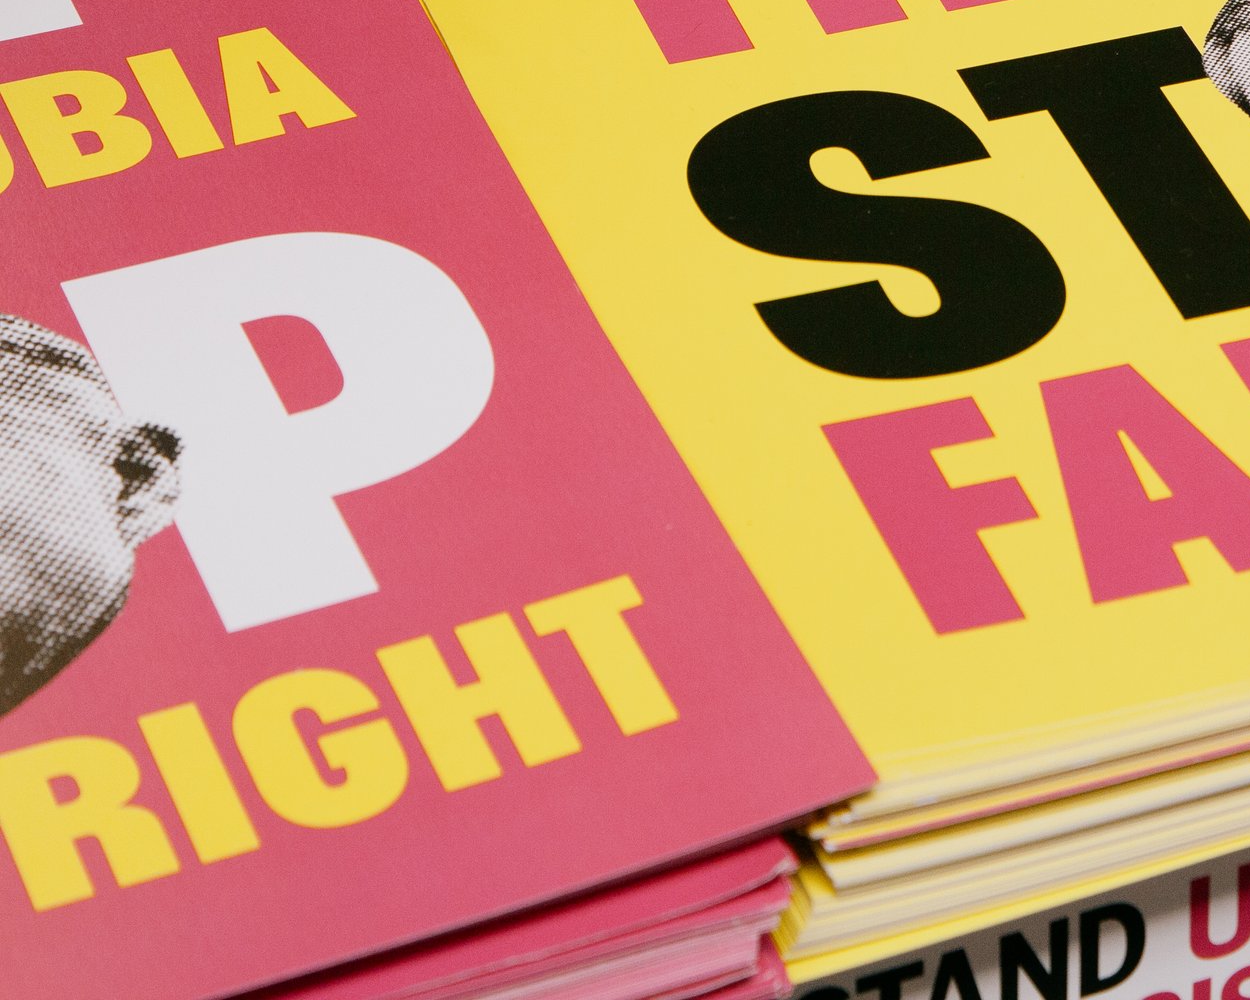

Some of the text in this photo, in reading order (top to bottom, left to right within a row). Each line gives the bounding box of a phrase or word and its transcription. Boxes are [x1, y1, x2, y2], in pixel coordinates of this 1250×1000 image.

[0, 27, 358, 195] BIA
[0, 573, 680, 912] RIGHT
[800, 902, 1147, 1000] AND
